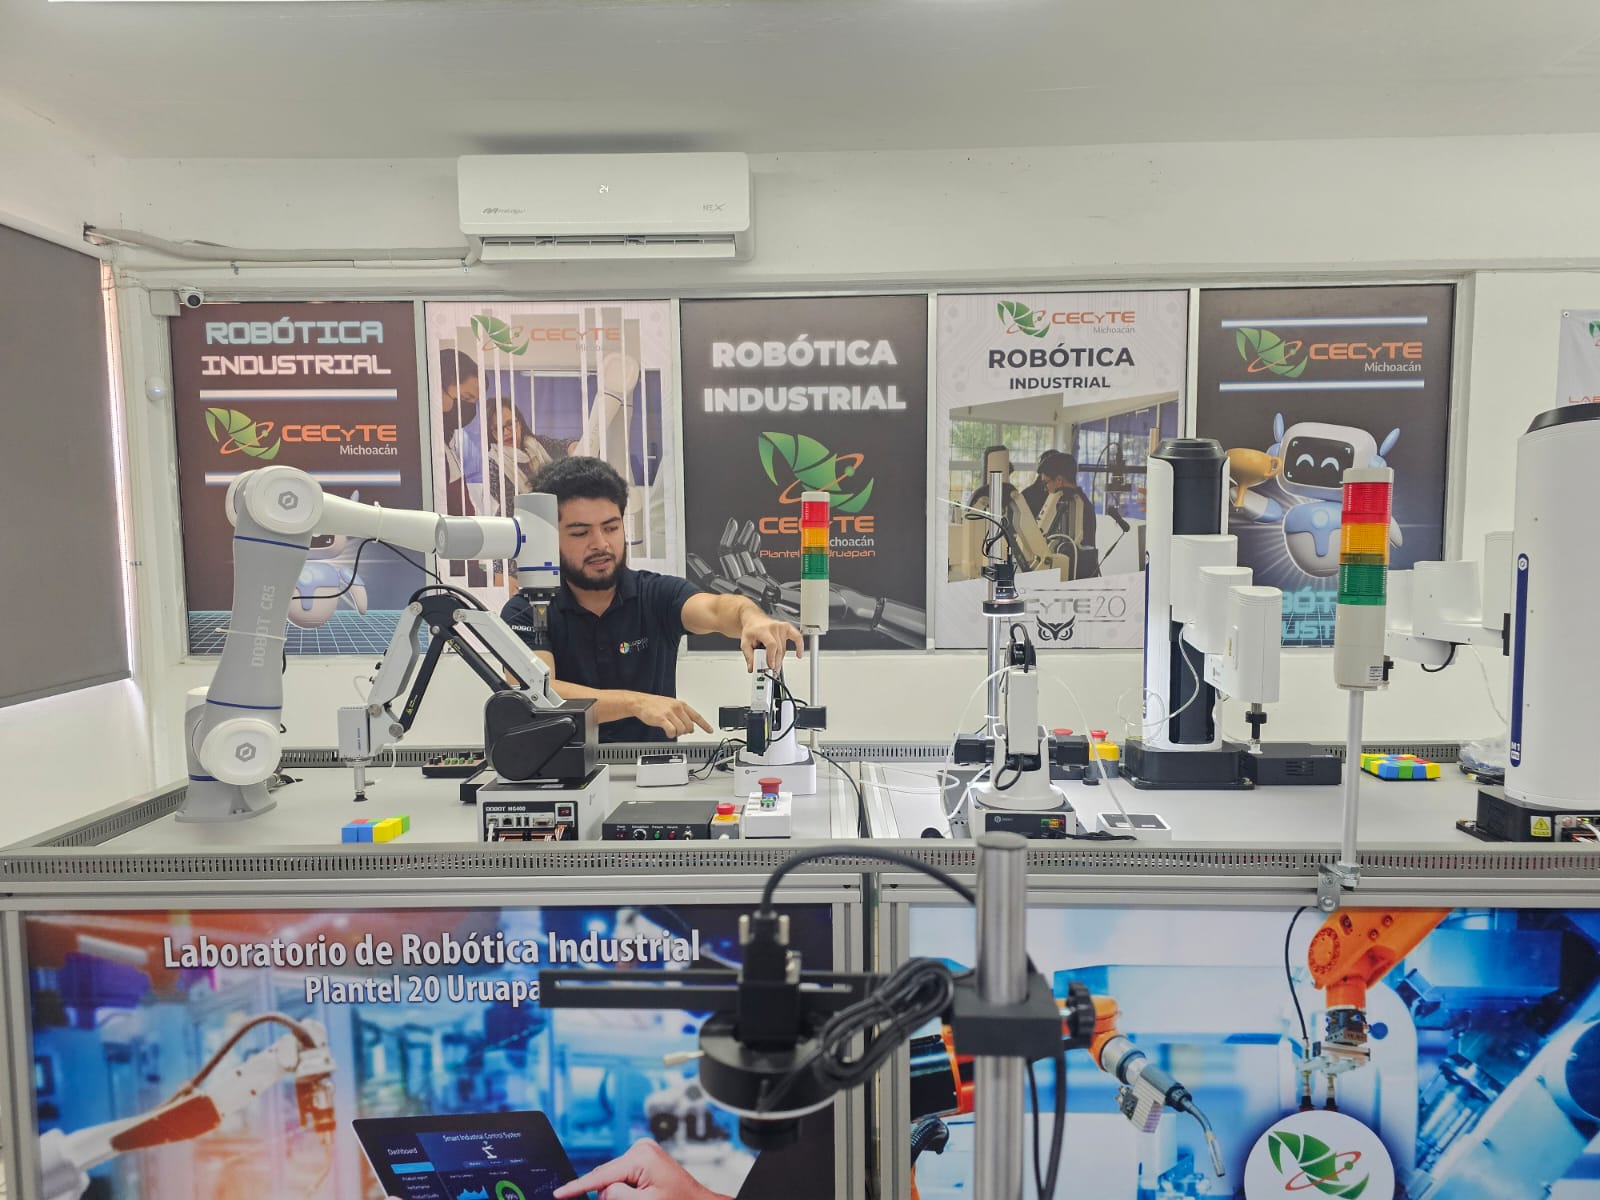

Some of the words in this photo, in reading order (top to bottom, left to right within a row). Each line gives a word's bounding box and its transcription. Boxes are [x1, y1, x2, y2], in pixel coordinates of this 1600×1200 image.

[599, 184, 609, 194] 24
[205, 316, 384, 345] ROBÓTICA
[1093, 325, 1136, 335] Michoacán
[712, 333, 898, 368] ROBÓTICA
[988, 342, 1135, 369] ROBÓTICA
[201, 354, 392, 376] INDUSTRIAL
[1364, 360, 1421, 373] Michoacán
[1010, 376, 1111, 390] INDUSTRIAL
[703, 384, 907, 413] INDUSTRIAL
[339, 443, 398, 456] Michoacán
[260, 584, 276, 610] CR5
[251, 616, 271, 667] DOBOT
[163, 934, 347, 968] Laboratorio
[355, 933, 394, 967] de
[402, 931, 539, 966] Robótica
[549, 928, 700, 963] Industrial
[305, 974, 401, 1004] Plantel
[408, 975, 440, 1003] 20
[447, 974, 540, 1008] Uruapa
